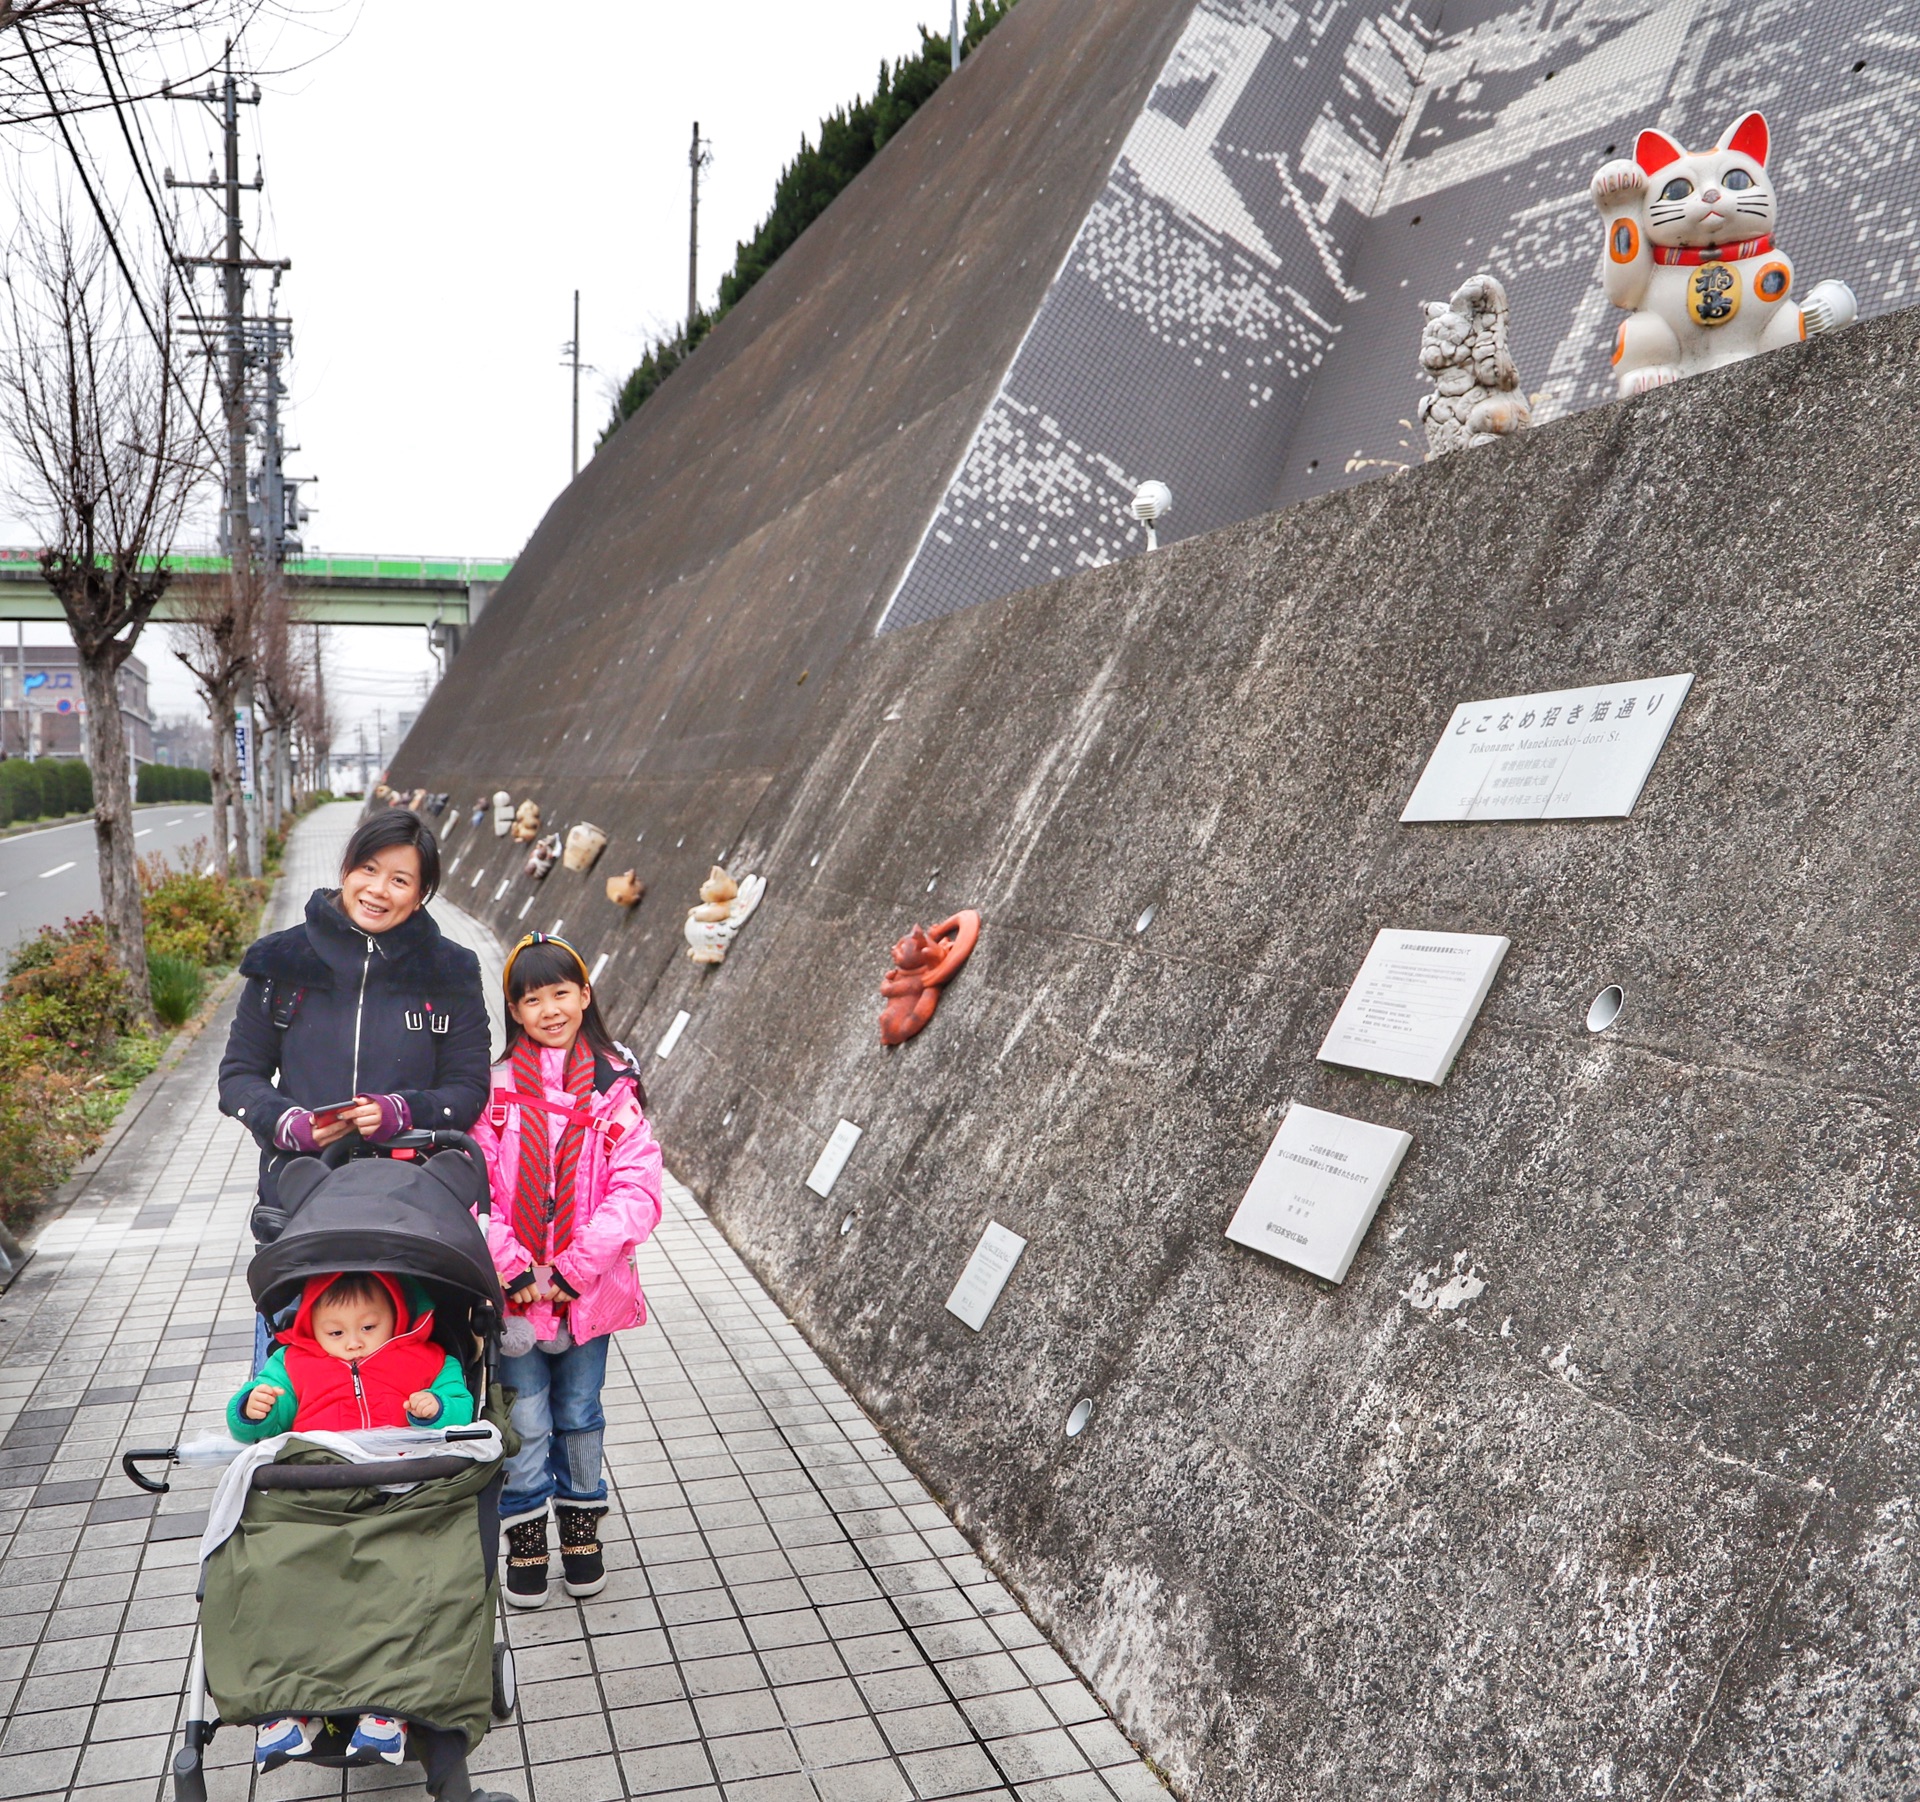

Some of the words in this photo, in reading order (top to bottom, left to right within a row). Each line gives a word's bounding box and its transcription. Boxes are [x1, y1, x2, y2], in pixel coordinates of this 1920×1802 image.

[1454, 693, 1665, 735] とこなめ招き猫通り
[1467, 742, 1515, 754] Tokoname
[1518, 732, 1604, 750] Manekineko-dori
[1607, 729, 1621, 742] St.
